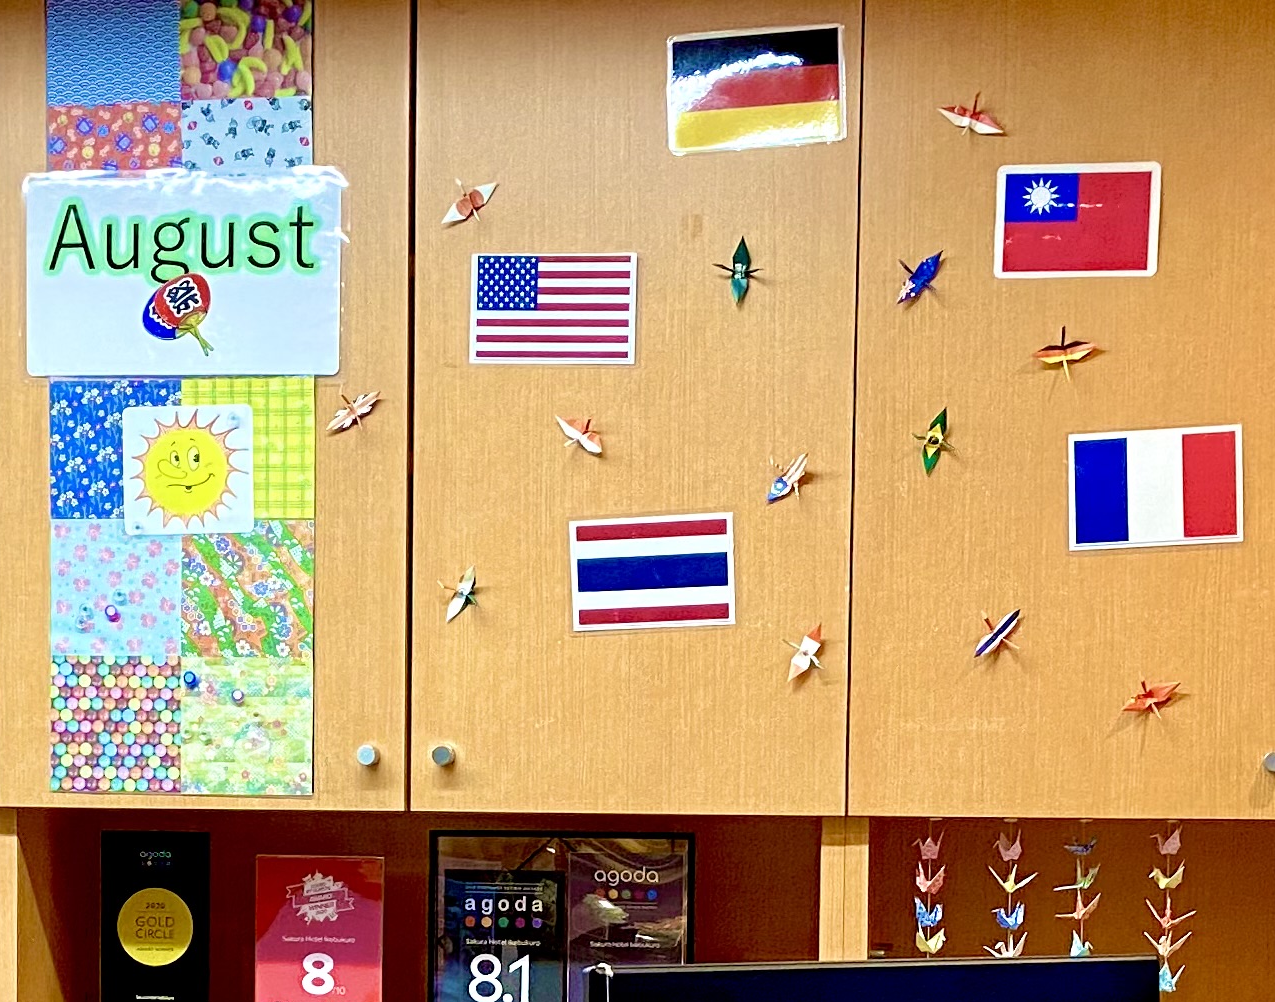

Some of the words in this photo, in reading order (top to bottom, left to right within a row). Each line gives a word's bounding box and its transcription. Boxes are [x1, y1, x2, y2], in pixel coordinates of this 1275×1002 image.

[49, 204, 315, 284] August
[594, 866, 659, 887] agoda
[465, 895, 544, 916] agoda
[135, 916, 175, 928] GOLD
[135, 928, 175, 940] CIRCLE
[302, 952, 335, 996] 8
